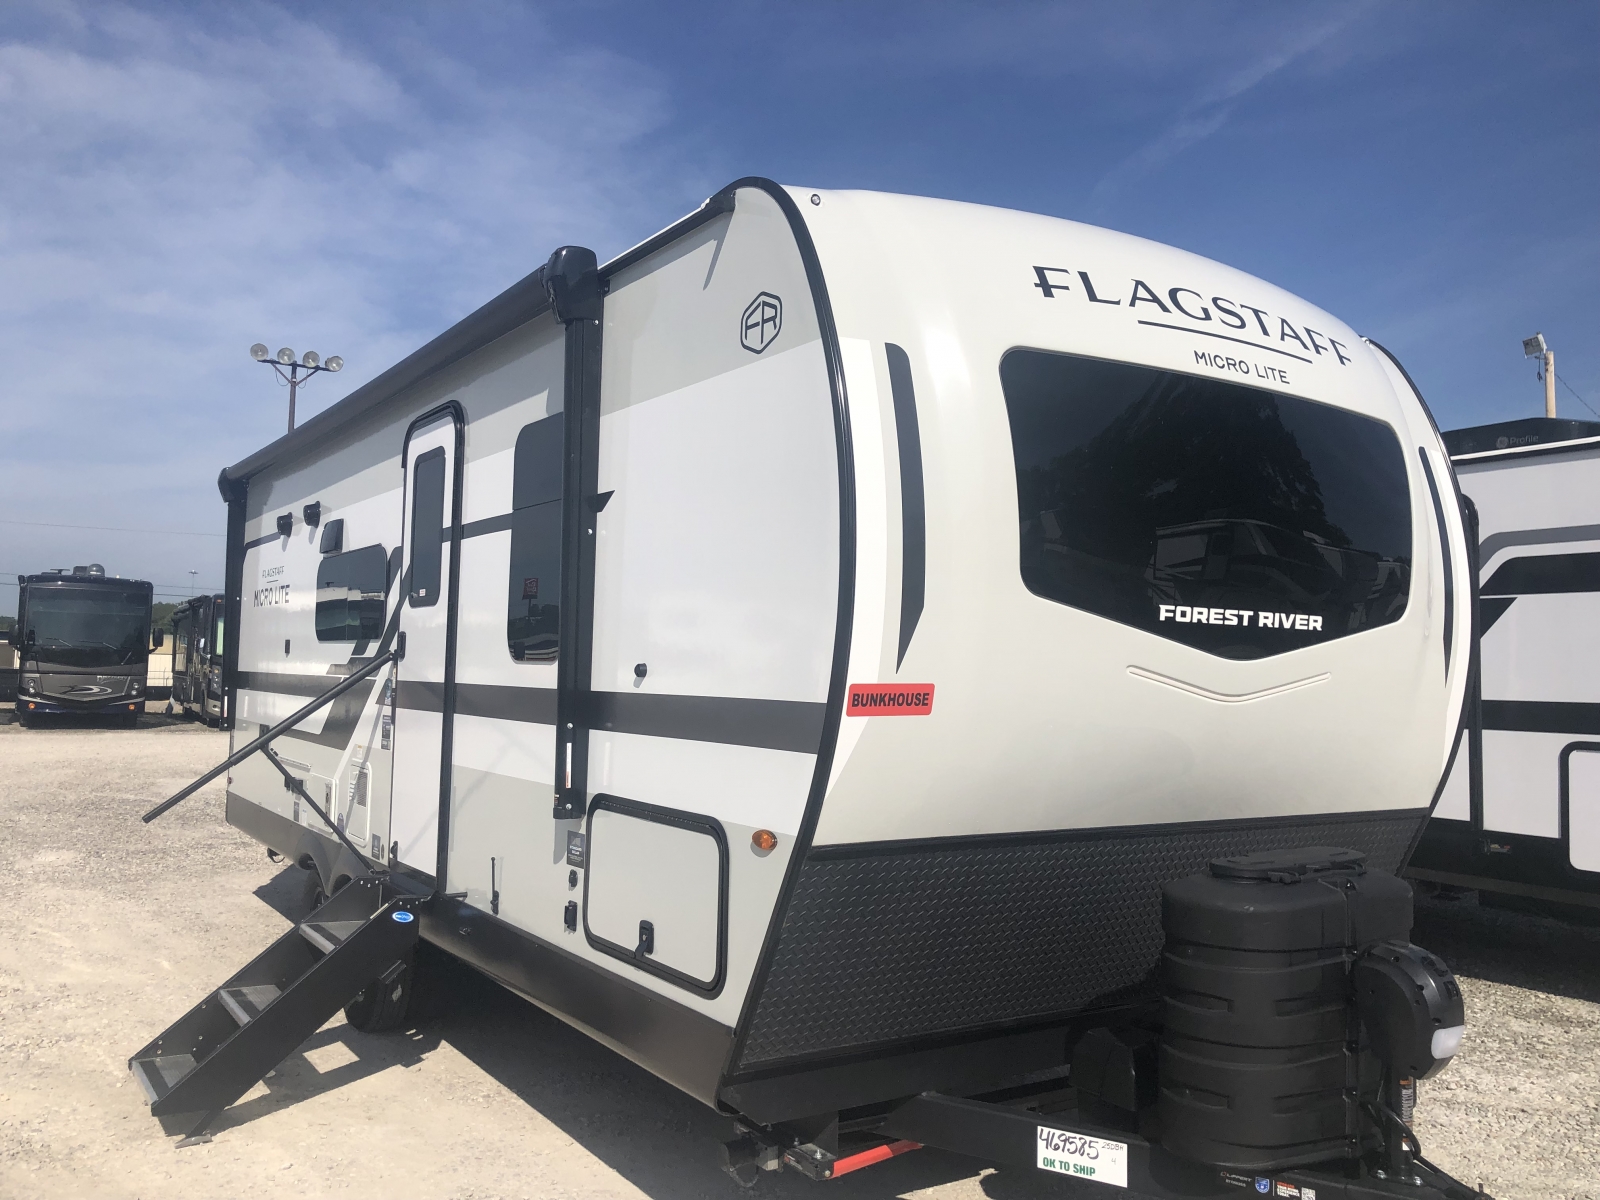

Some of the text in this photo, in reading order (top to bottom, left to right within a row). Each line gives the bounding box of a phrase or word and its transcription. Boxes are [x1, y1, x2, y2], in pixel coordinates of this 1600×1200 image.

[1032, 265, 1352, 366] FLAGSTAFF
[1194, 350, 1290, 384] MICRO LITE
[1510, 435, 1539, 446] Profile
[262, 565, 285, 579] FLAGSTAFF
[253, 584, 290, 608] MICRO LITE
[1159, 604, 1323, 631] FOREST RIVER
[851, 692, 930, 708] BUNKHOUSE
[1039, 1127, 1100, 1160] 469585
[1043, 1156, 1096, 1177] OK TO SHIP
